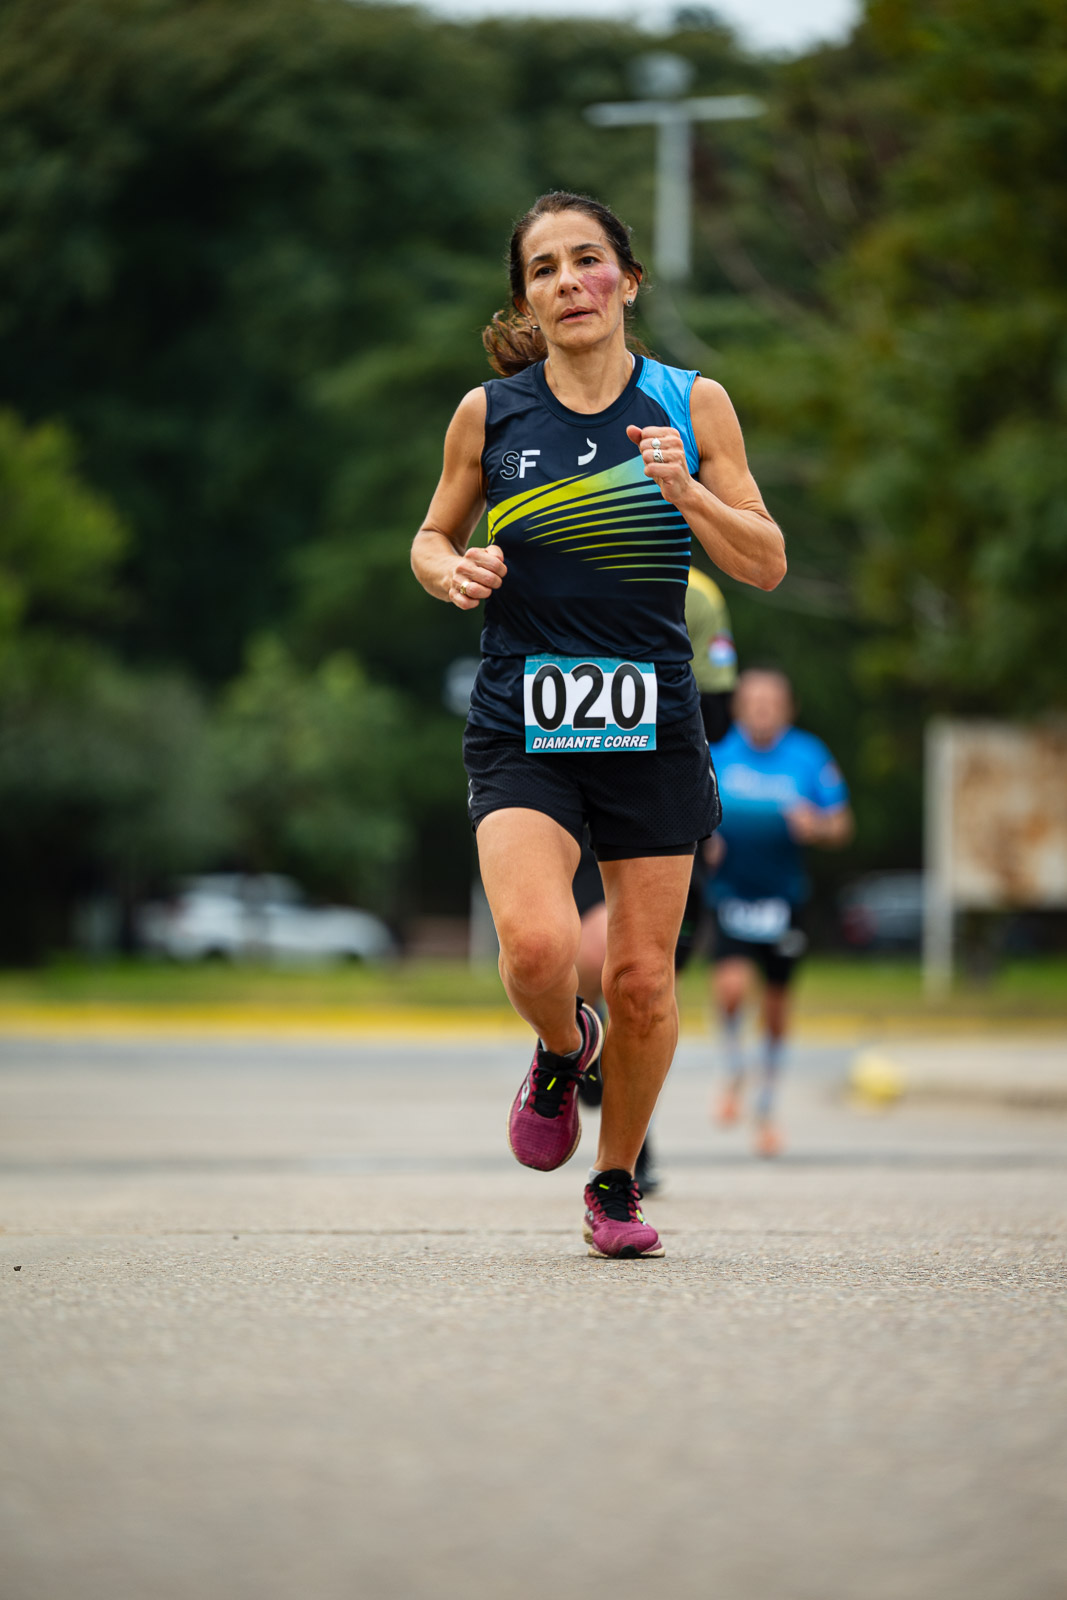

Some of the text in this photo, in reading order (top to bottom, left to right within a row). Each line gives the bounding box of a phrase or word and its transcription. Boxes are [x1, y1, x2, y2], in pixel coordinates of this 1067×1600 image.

[500, 449, 541, 480] SF
[531, 662, 646, 732] 020
[532, 735, 649, 750] DIAMANTE CORRE
